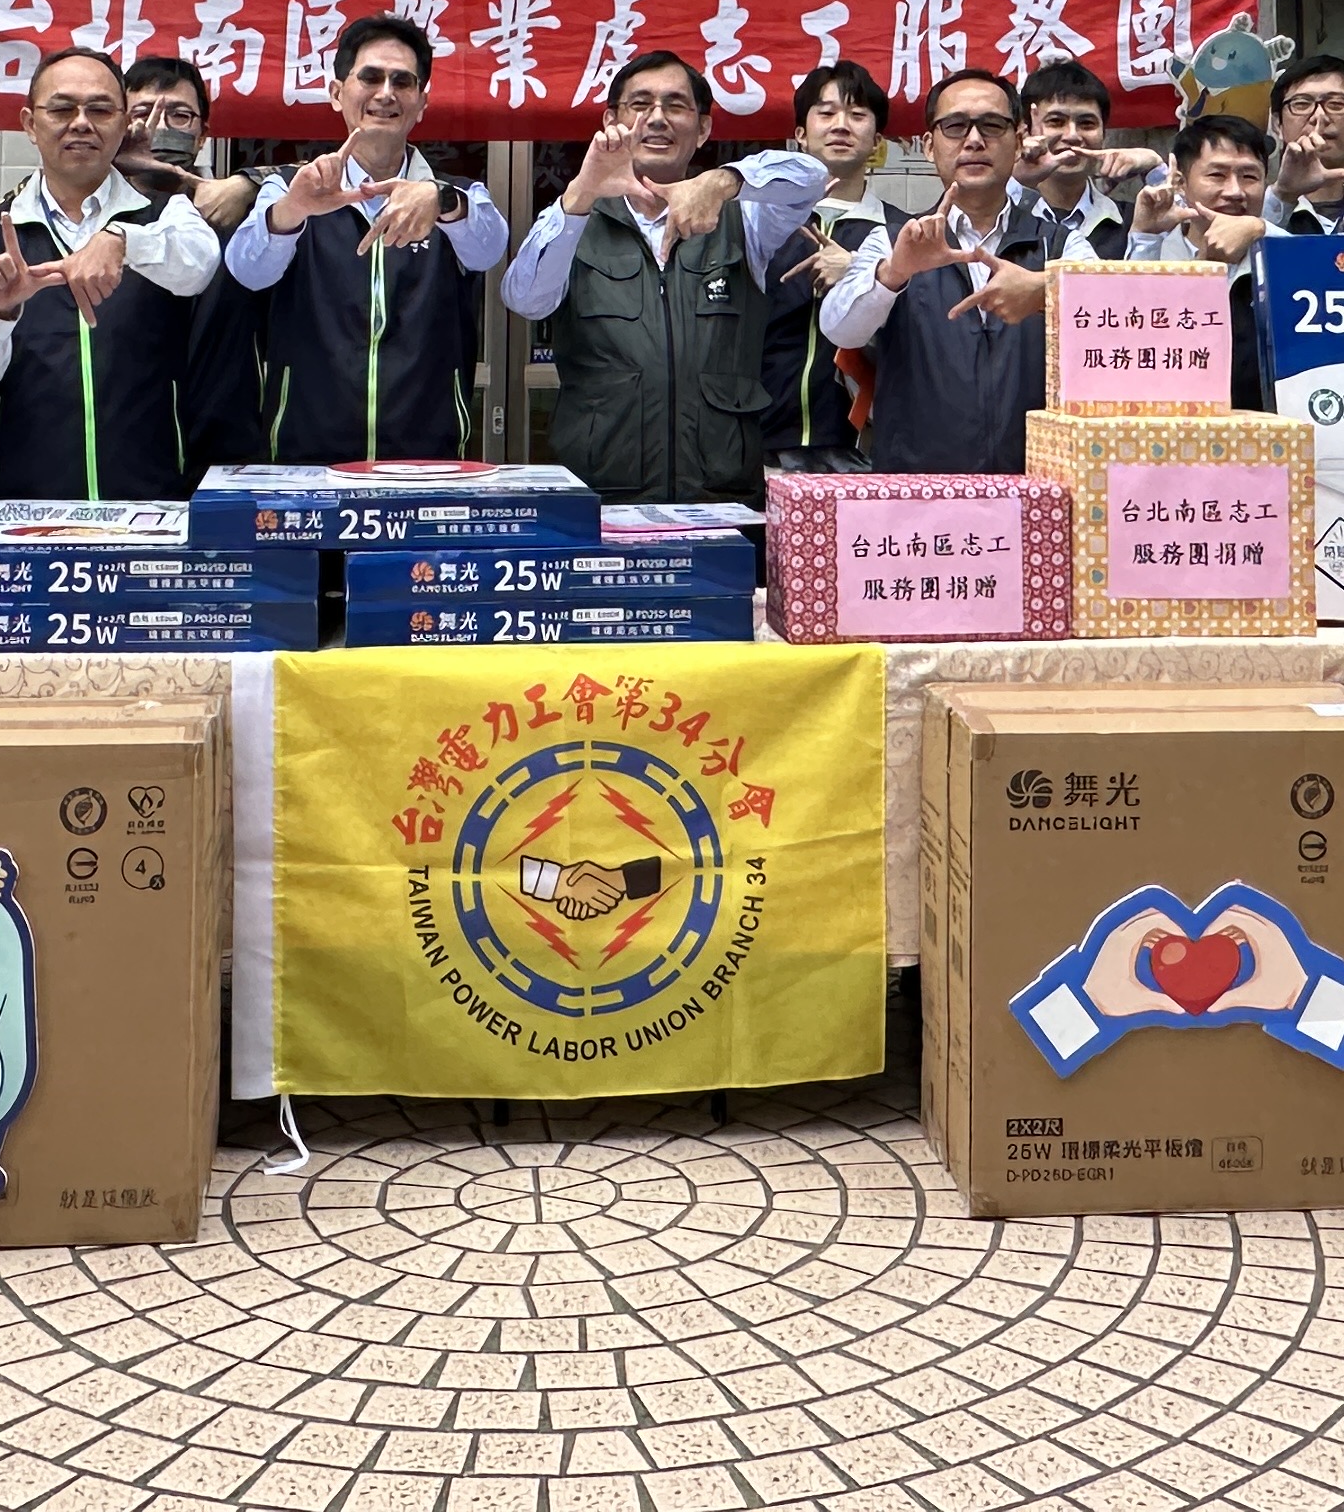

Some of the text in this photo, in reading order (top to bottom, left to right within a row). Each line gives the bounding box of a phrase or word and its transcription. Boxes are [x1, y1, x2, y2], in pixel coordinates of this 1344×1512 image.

[1073, 305, 1224, 332] 台北南區志工
[1083, 346, 1211, 372] 服務團捐贈
[338, 509, 407, 540] 25W
[1121, 498, 1279, 525] 台北南區志工
[851, 531, 1011, 558] 台北南區志工
[1133, 541, 1266, 568] 服務團捐贈
[48, 561, 118, 593] 25W
[494, 560, 562, 591] 25W
[862, 575, 998, 602] 服務團捐贈
[47, 613, 117, 644] 25W
[493, 610, 562, 642] 25W
[391, 672, 775, 846] 台灣電力工會第34分會
[1063, 772, 1141, 808] 舞光
[409, 855, 768, 1062] TAIWAN POWER LABOR UNION BRANCH 34
